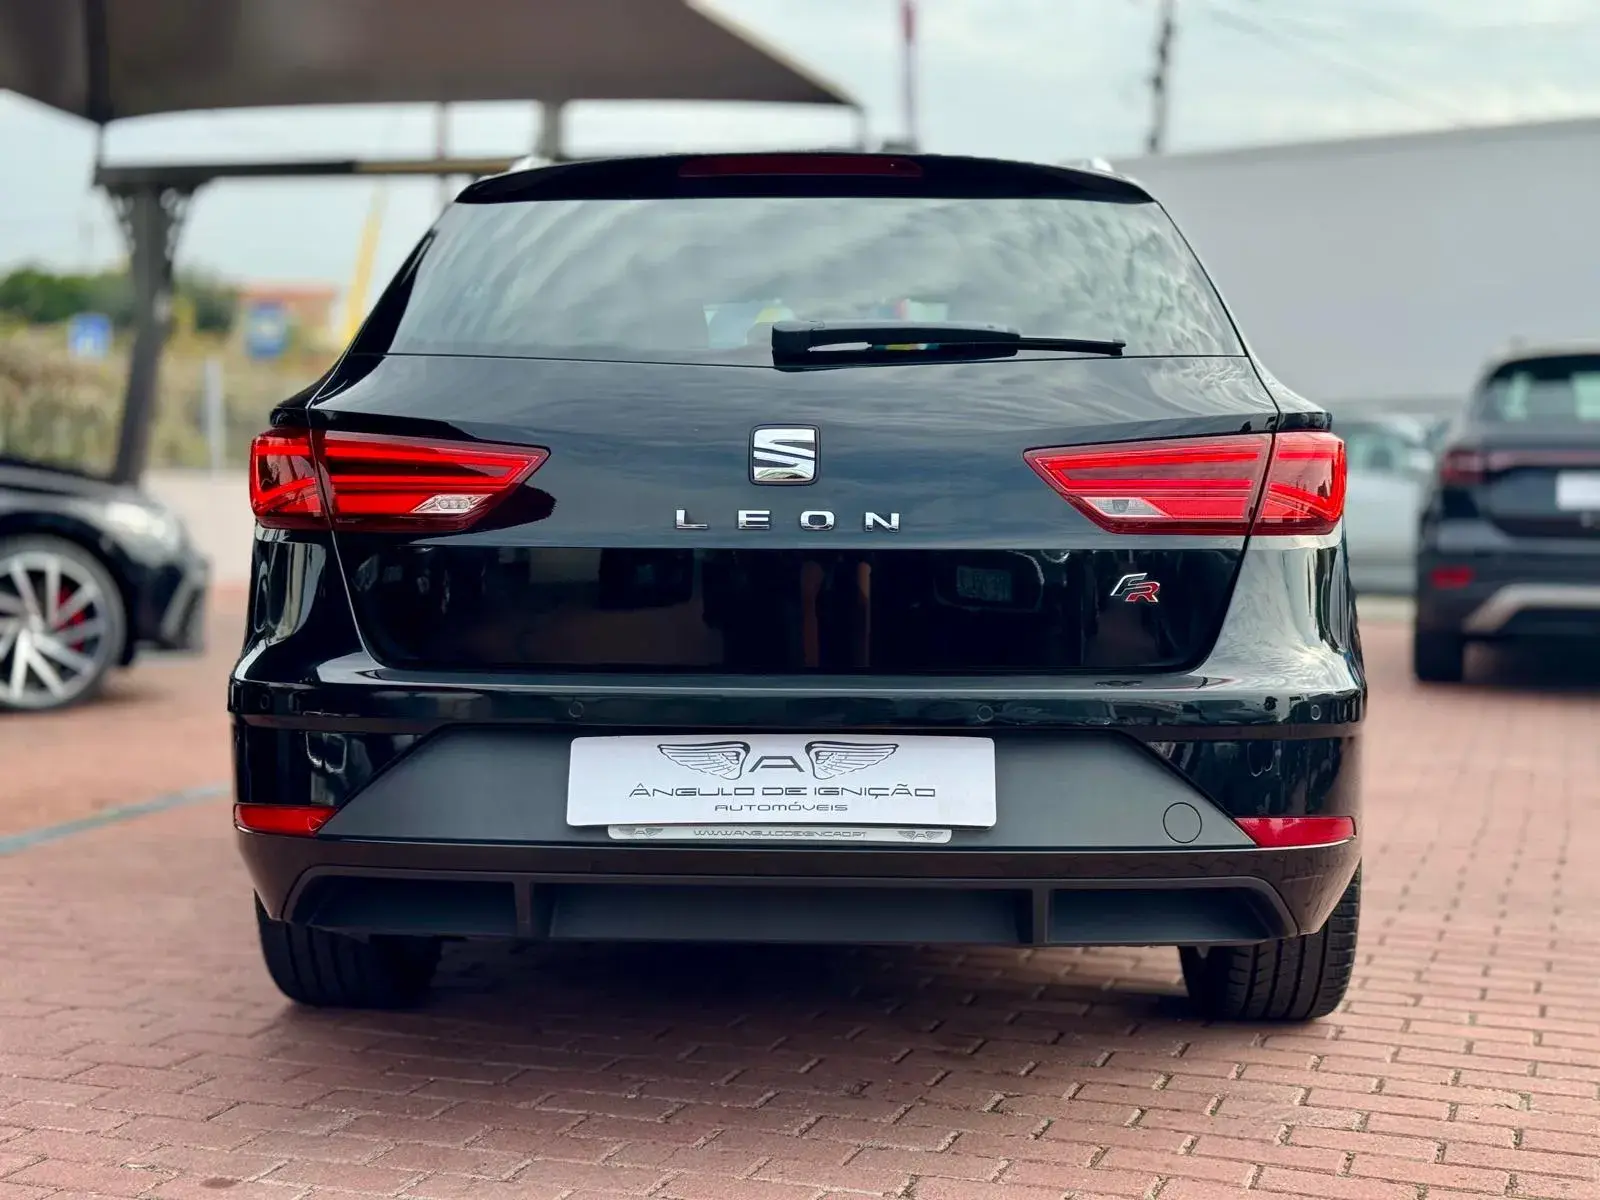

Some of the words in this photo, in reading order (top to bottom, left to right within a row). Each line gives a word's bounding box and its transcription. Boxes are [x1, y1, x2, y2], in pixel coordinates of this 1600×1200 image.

[675, 509, 900, 532] LEON
[1110, 572, 1160, 603] FR
[748, 755, 805, 772] A
[629, 782, 755, 798] ÂNGULO
[761, 786, 808, 796] DE
[814, 783, 936, 799] IGNIÇÃO
[714, 801, 848, 811] AUTOMÓVEIS
